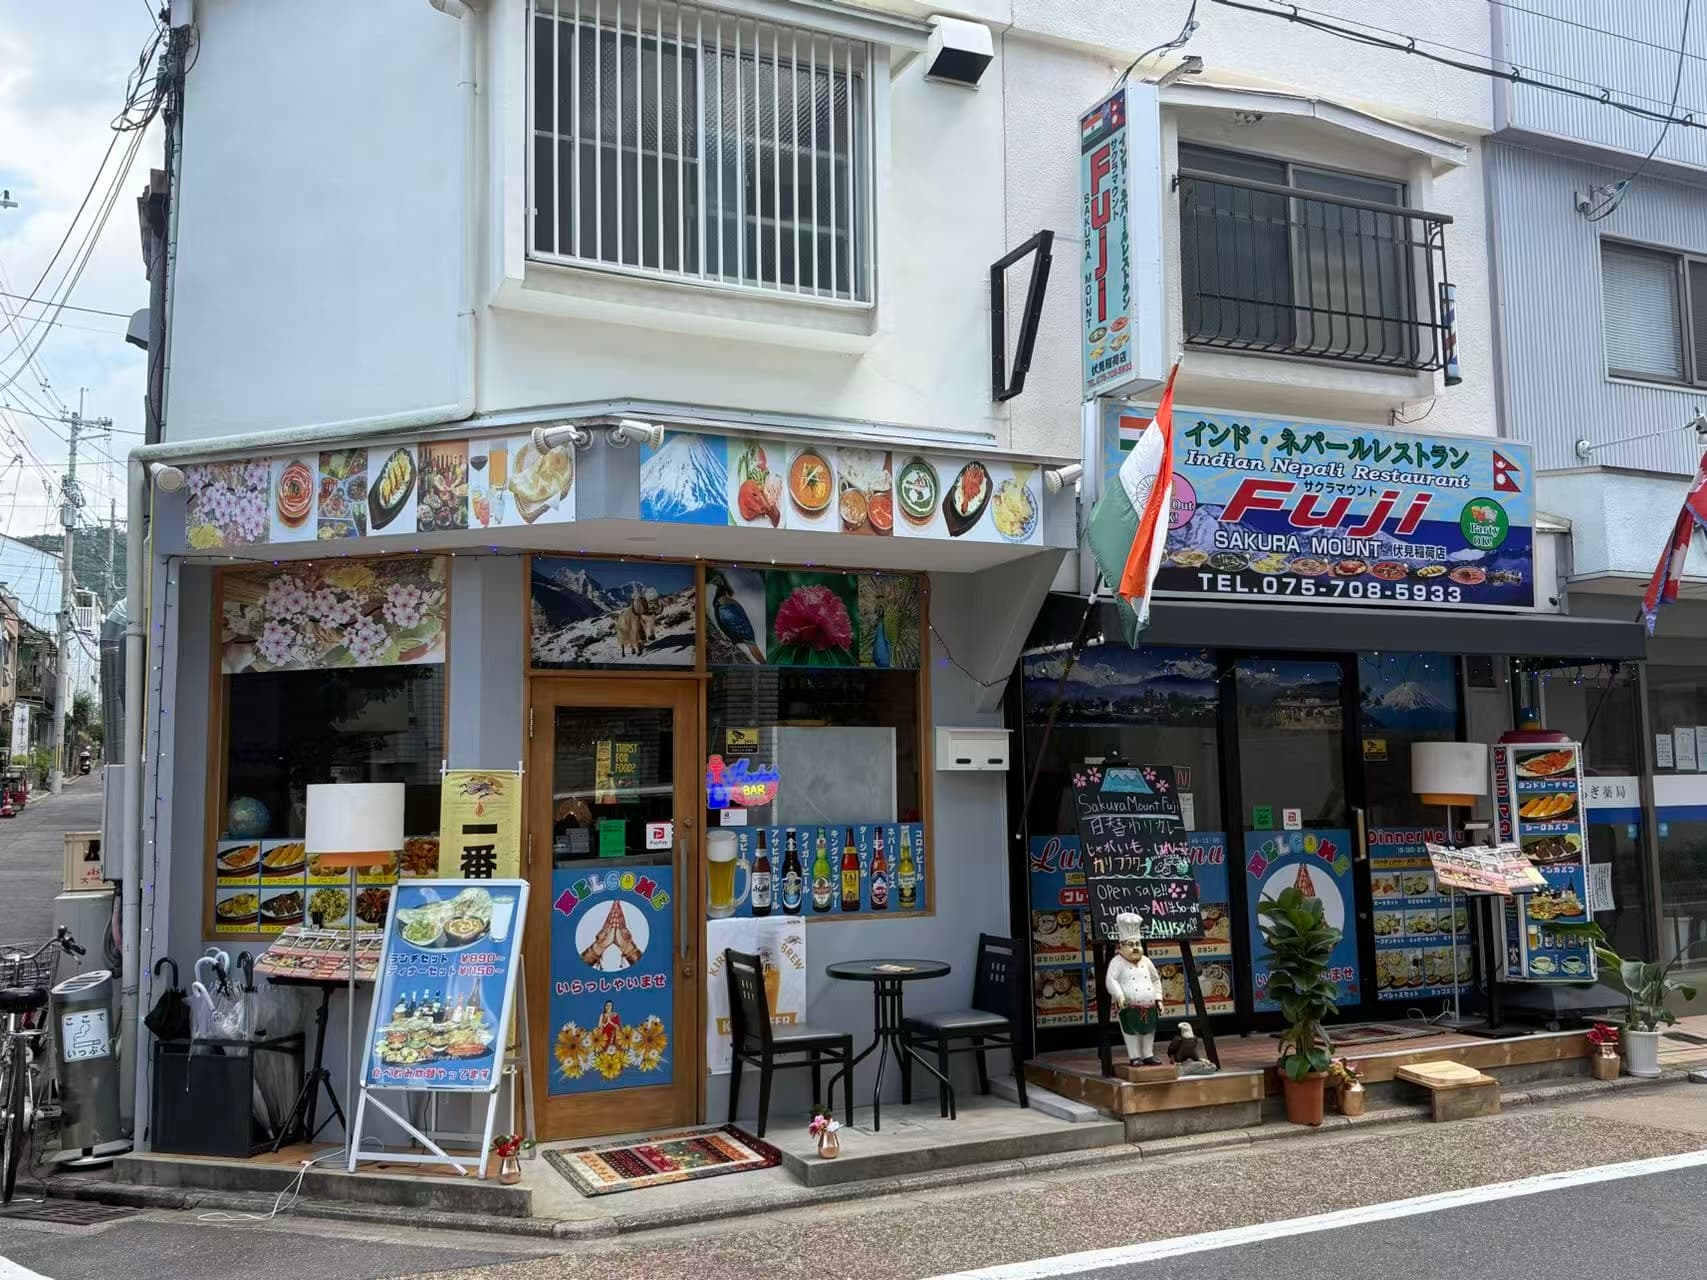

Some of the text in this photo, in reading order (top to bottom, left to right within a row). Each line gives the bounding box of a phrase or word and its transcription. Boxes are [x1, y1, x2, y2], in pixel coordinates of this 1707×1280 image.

[1111, 138, 1119, 221] サクラマウント
[1090, 142, 1112, 323] Fuji
[1084, 193, 1093, 329] SAKURA MOUNT
[1185, 421, 1470, 470] インド・ネパールレストラン
[1184, 450, 1470, 489] Indian Nepali Restaurant
[1303, 480, 1378, 498] サクラマウント
[1217, 477, 1434, 538] Fuji
[1470, 522, 1500, 537] Party
[1214, 530, 1382, 559] SAKURA MOUNT
[1392, 543, 1447, 561] 伏見稲荷店
[1197, 573, 1462, 603] TEL.075-708-5933
[616, 752, 629, 762] FOR
[743, 784, 765, 796] BAR
[1585, 785, 1626, 800] ぎ薬局
[1367, 829, 1423, 846] Dinner
[1246, 831, 1352, 880] WELCOME
[553, 870, 671, 917] WELCOME
[1096, 884, 1131, 900] Open
[390, 953, 449, 965] ランチセット
[780, 943, 805, 971] BREW
[556, 972, 667, 996] いらっしゃいませ
